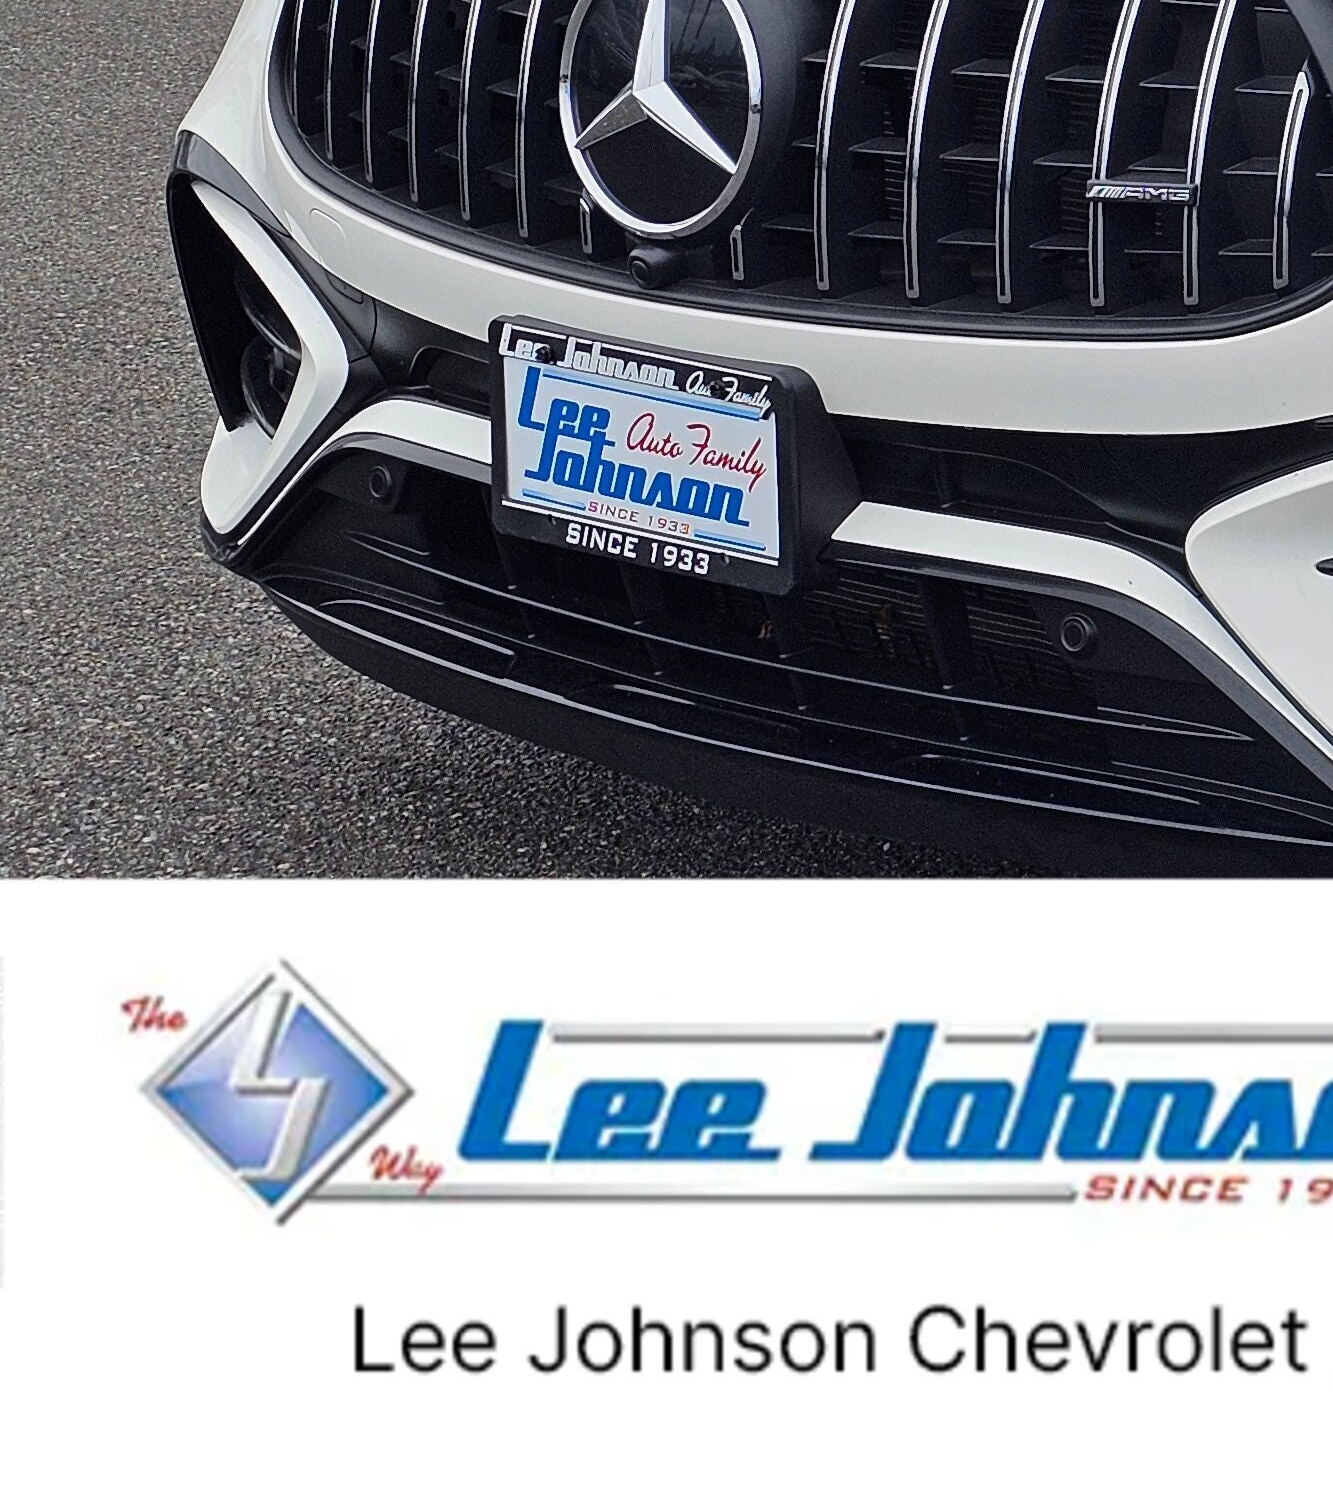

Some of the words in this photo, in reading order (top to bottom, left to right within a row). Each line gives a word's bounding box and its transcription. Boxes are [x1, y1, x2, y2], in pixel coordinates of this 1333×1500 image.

[557, 337, 680, 391] Johnson
[518, 366, 616, 446] Lee
[626, 412, 684, 458] Auto
[687, 424, 768, 493] Family
[524, 426, 750, 527] Johnson
[587, 501, 639, 523] SINCE
[647, 516, 691, 535] 1933
[565, 524, 639, 558] SINCE
[651, 541, 711, 575] 1933
